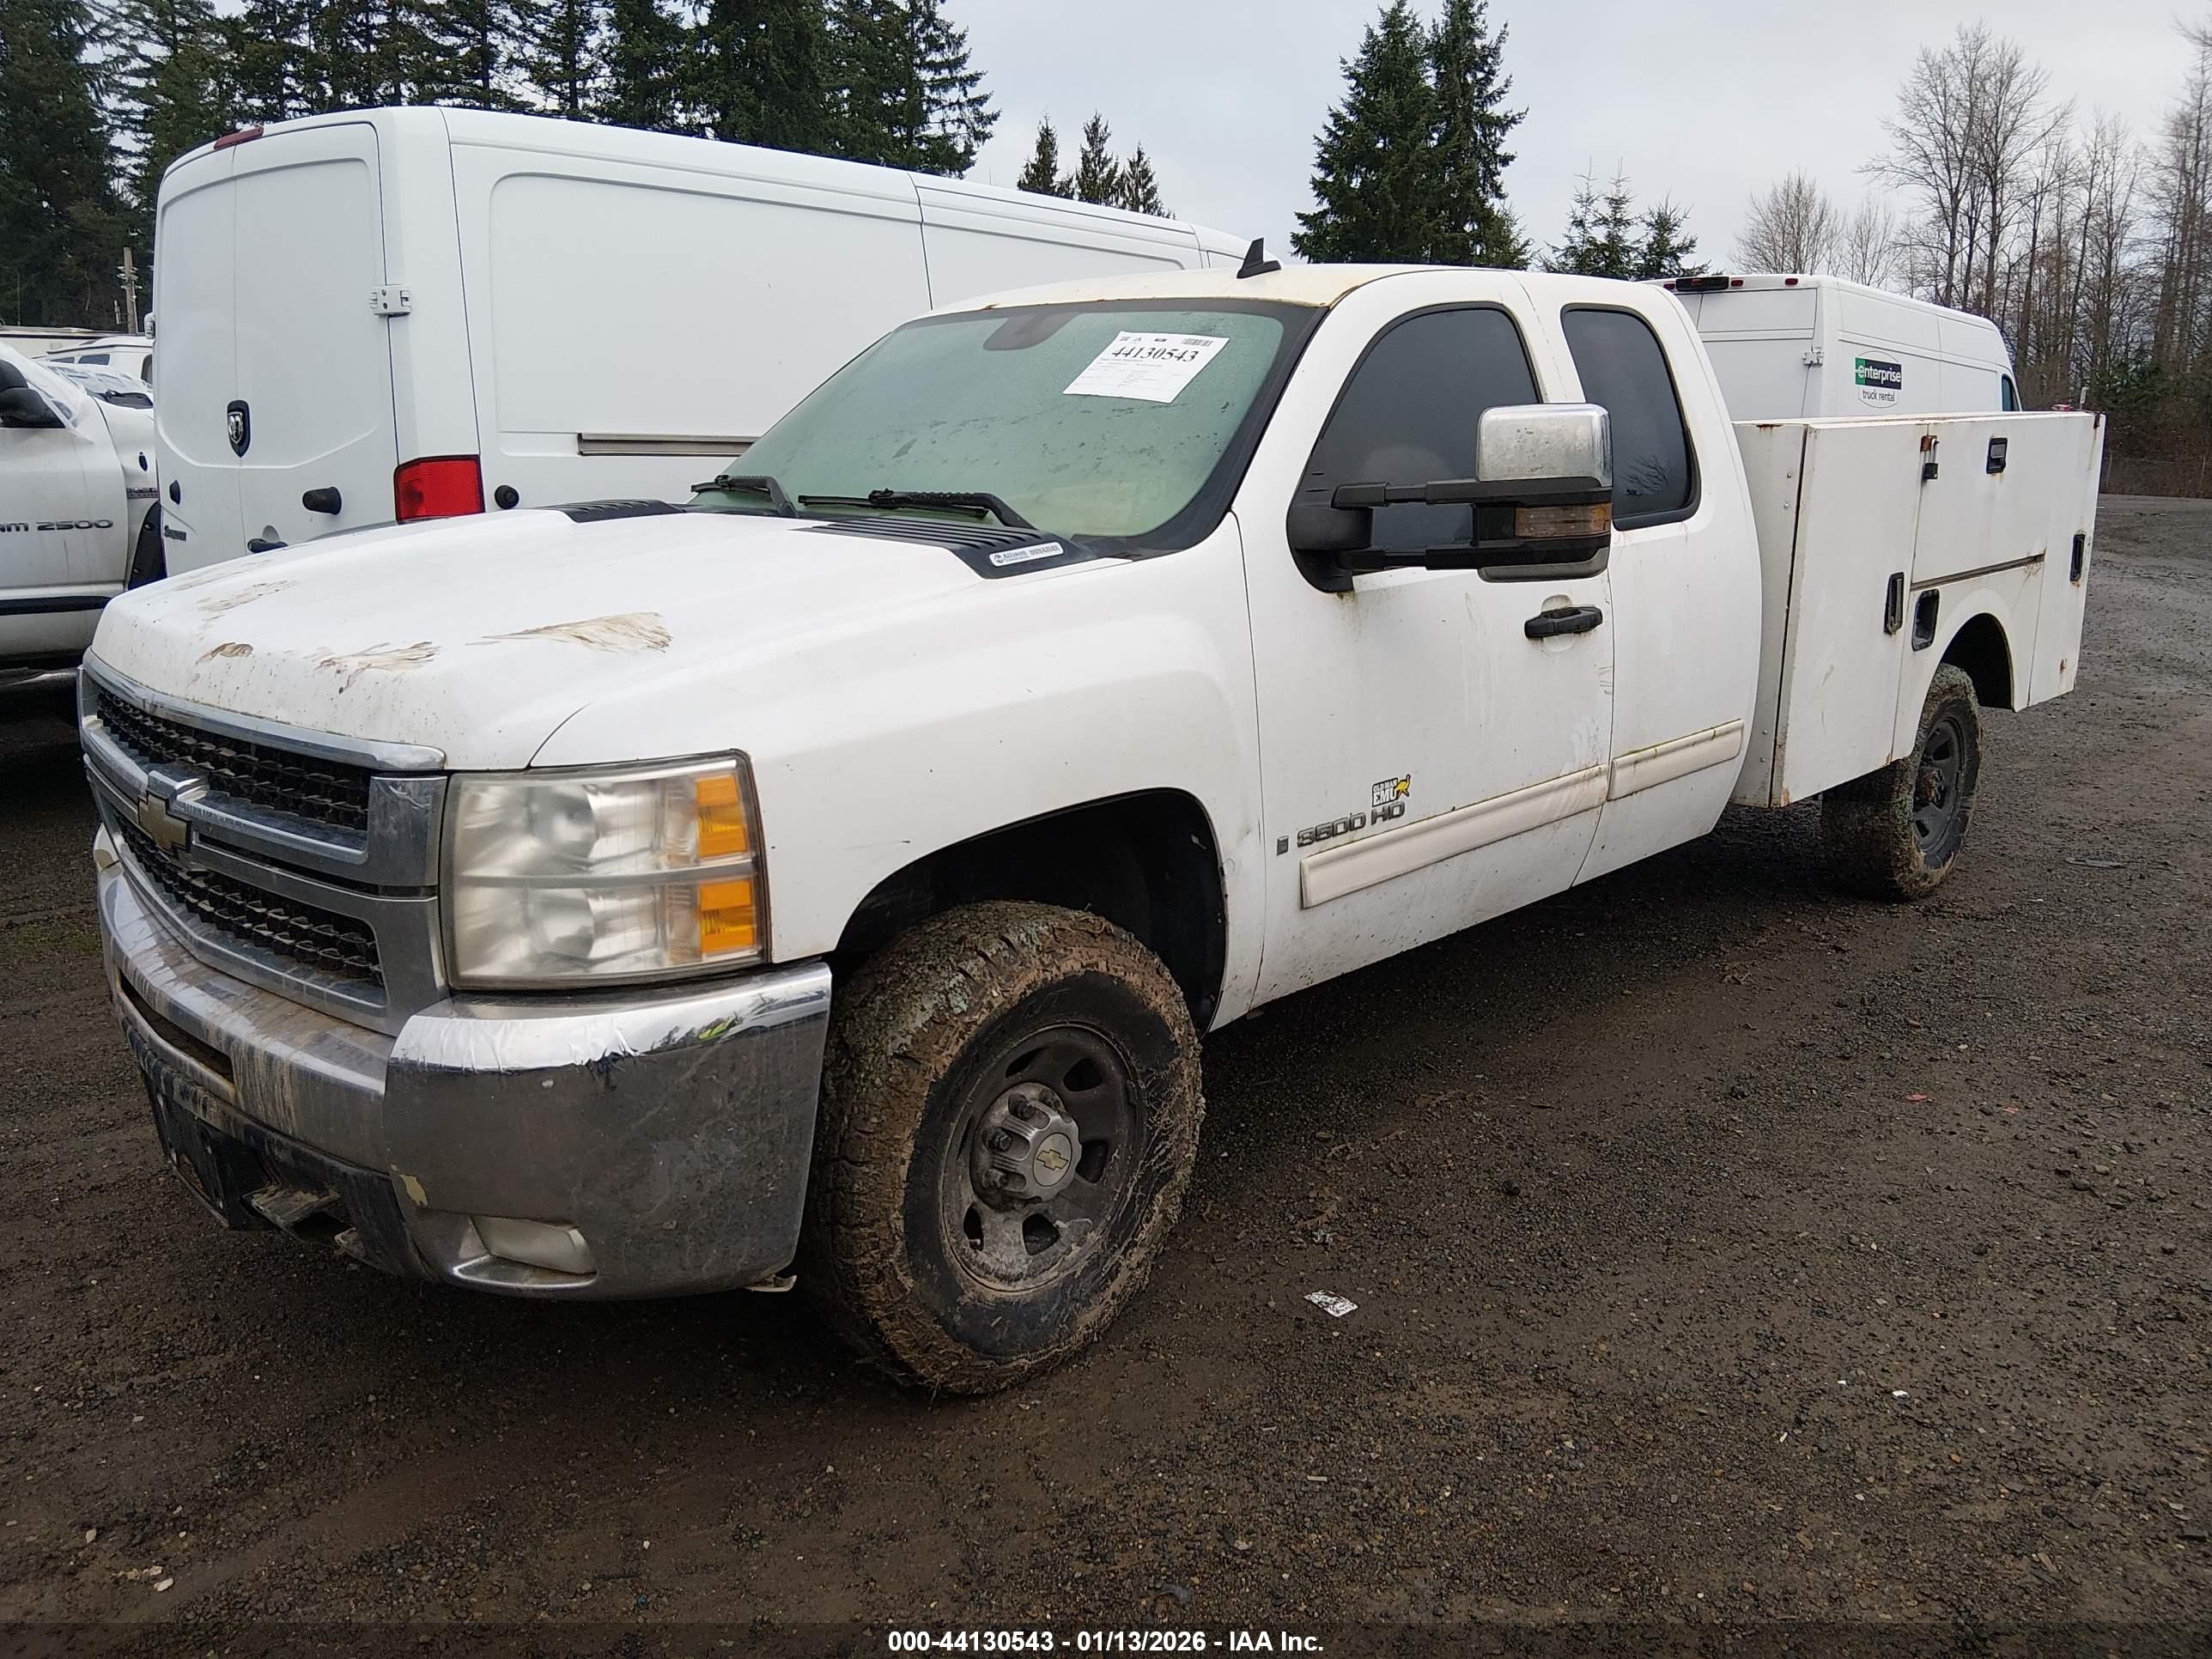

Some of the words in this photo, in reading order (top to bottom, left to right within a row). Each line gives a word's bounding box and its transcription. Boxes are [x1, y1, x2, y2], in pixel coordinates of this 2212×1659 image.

[1111, 346, 1200, 362] 44130543
[1856, 365, 1901, 385] enterprise
[1863, 389, 1877, 400] truck
[1878, 392, 1895, 402] rental
[36, 520, 113, 532] 2500
[1373, 782, 1385, 793] OLD
[1384, 779, 1397, 789] MAN
[1373, 787, 1397, 805] EMU
[1297, 812, 1366, 848] 3500
[1371, 801, 1405, 825] HD
